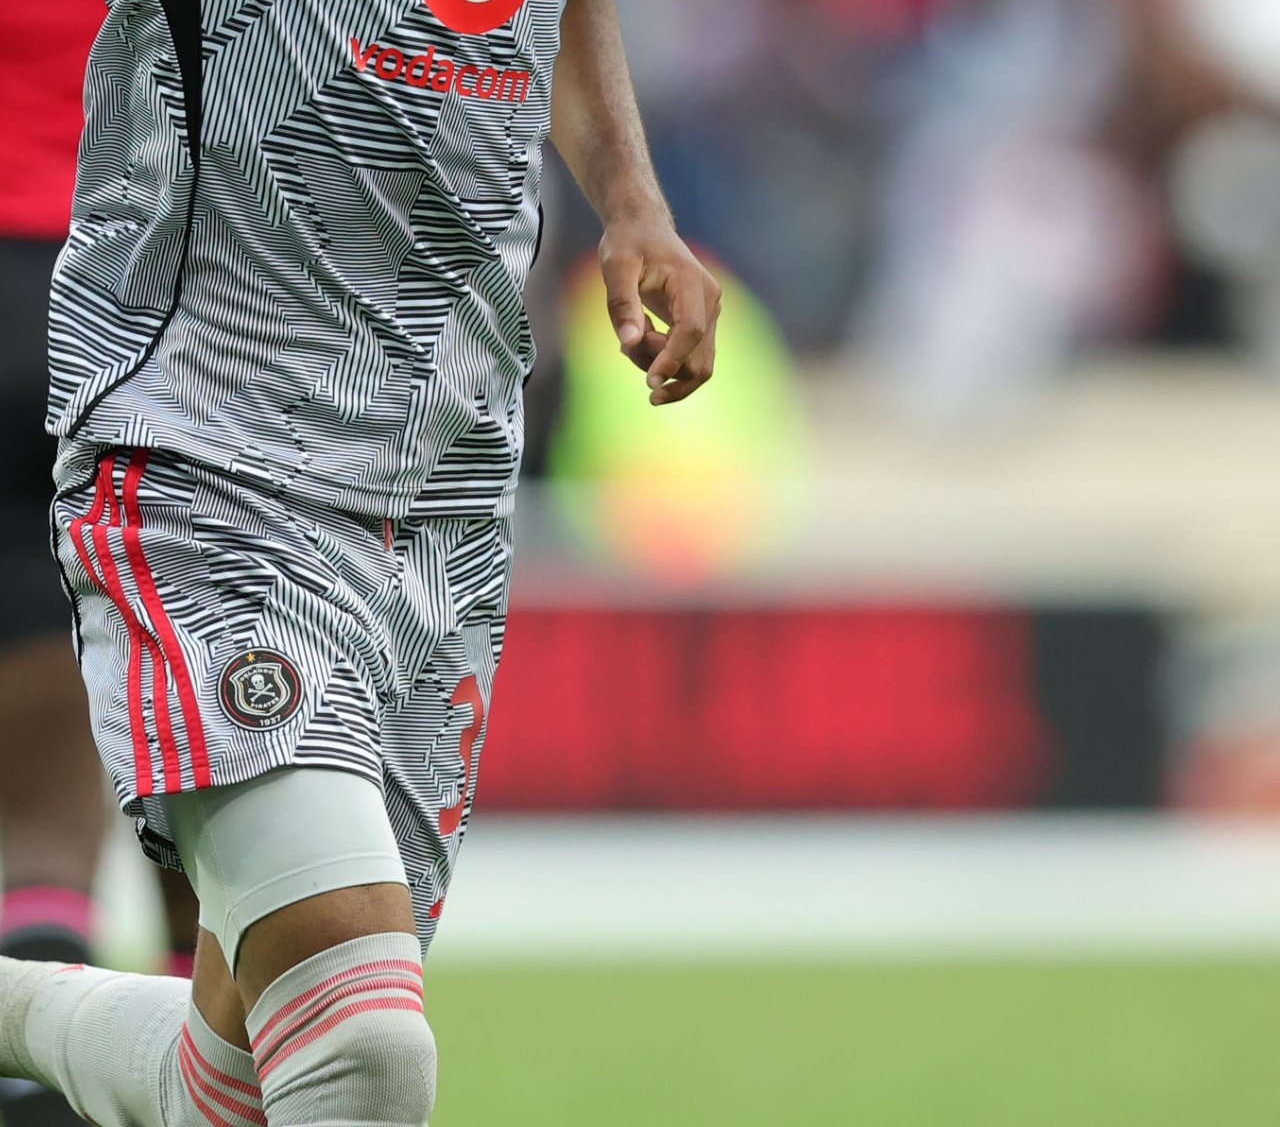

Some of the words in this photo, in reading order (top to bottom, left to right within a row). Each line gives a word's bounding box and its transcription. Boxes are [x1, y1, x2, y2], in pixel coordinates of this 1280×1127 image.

[350, 37, 530, 103] vodacom
[240, 668, 274, 681] ORLANDO
[250, 696, 279, 709] PIRATES
[259, 715, 281, 726] 1937
